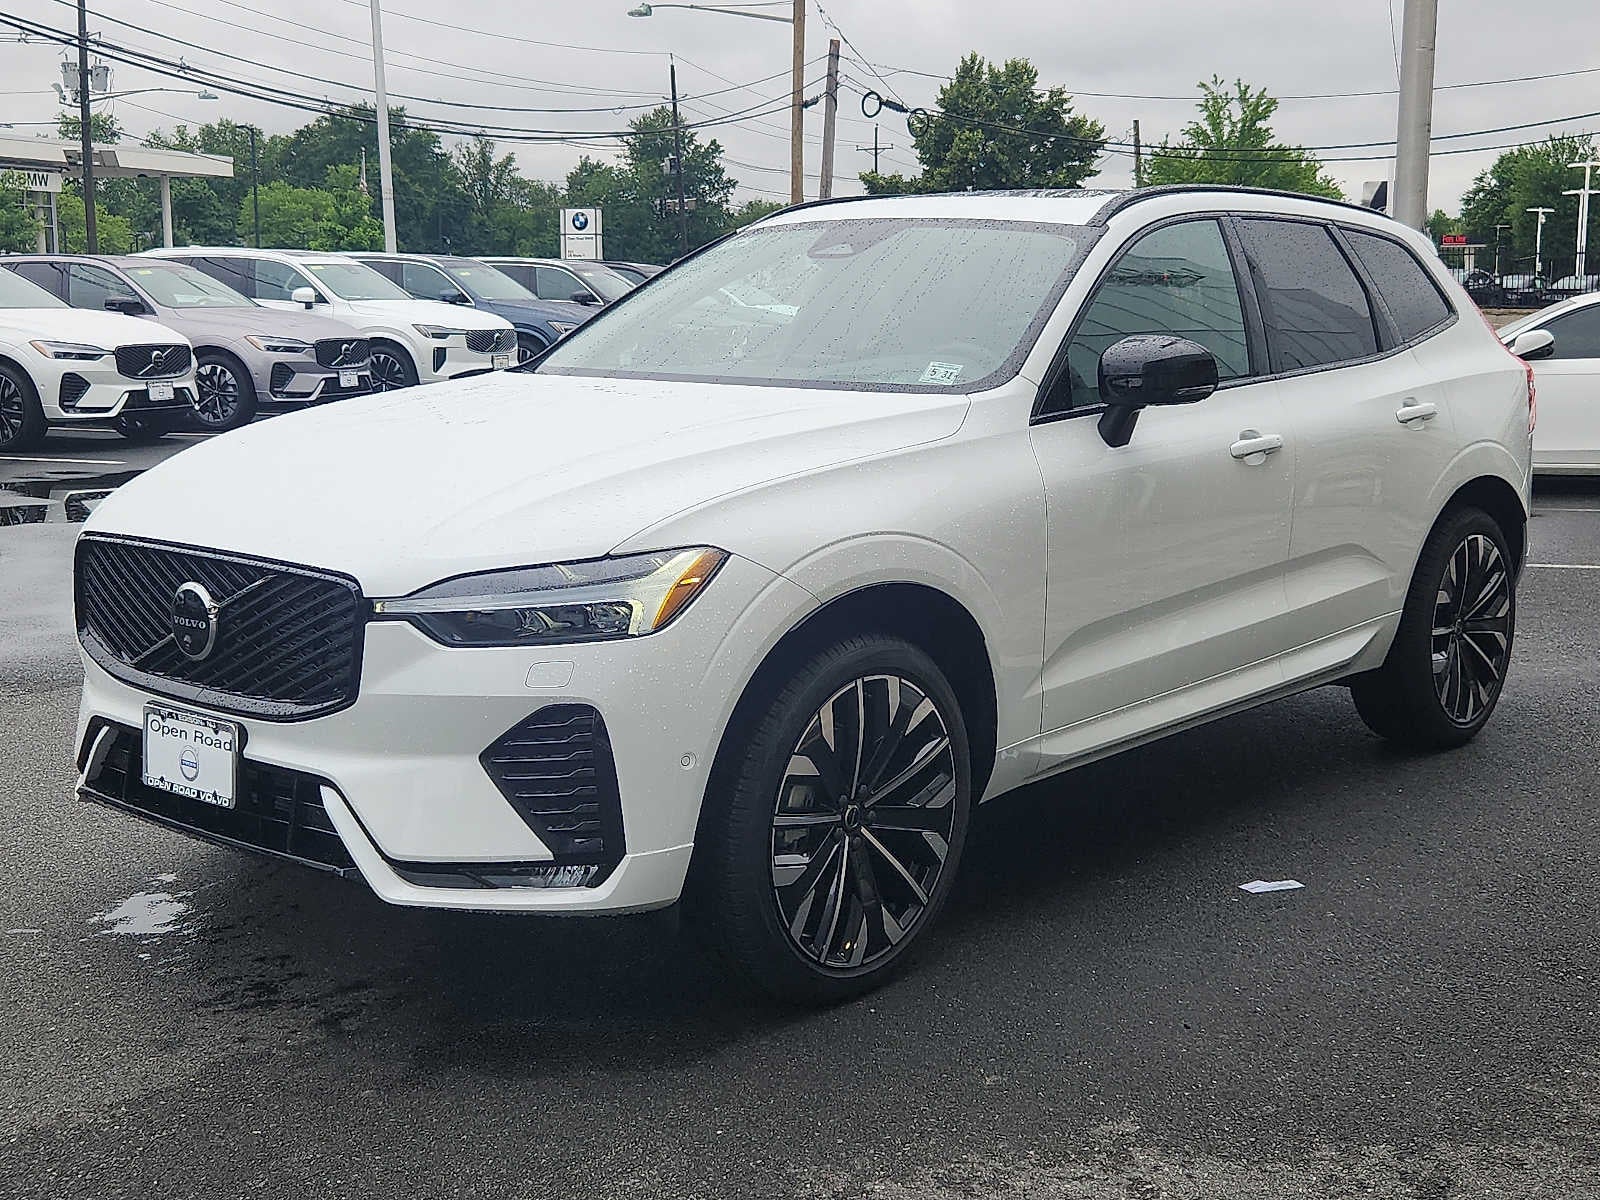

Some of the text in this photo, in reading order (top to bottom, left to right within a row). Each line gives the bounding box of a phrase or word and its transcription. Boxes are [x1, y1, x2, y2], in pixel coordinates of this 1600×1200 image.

[173, 615, 206, 629] VOLVO
[150, 719, 233, 752] Open Road
[148, 777, 229, 807] OPEN ROAD VOLVO
